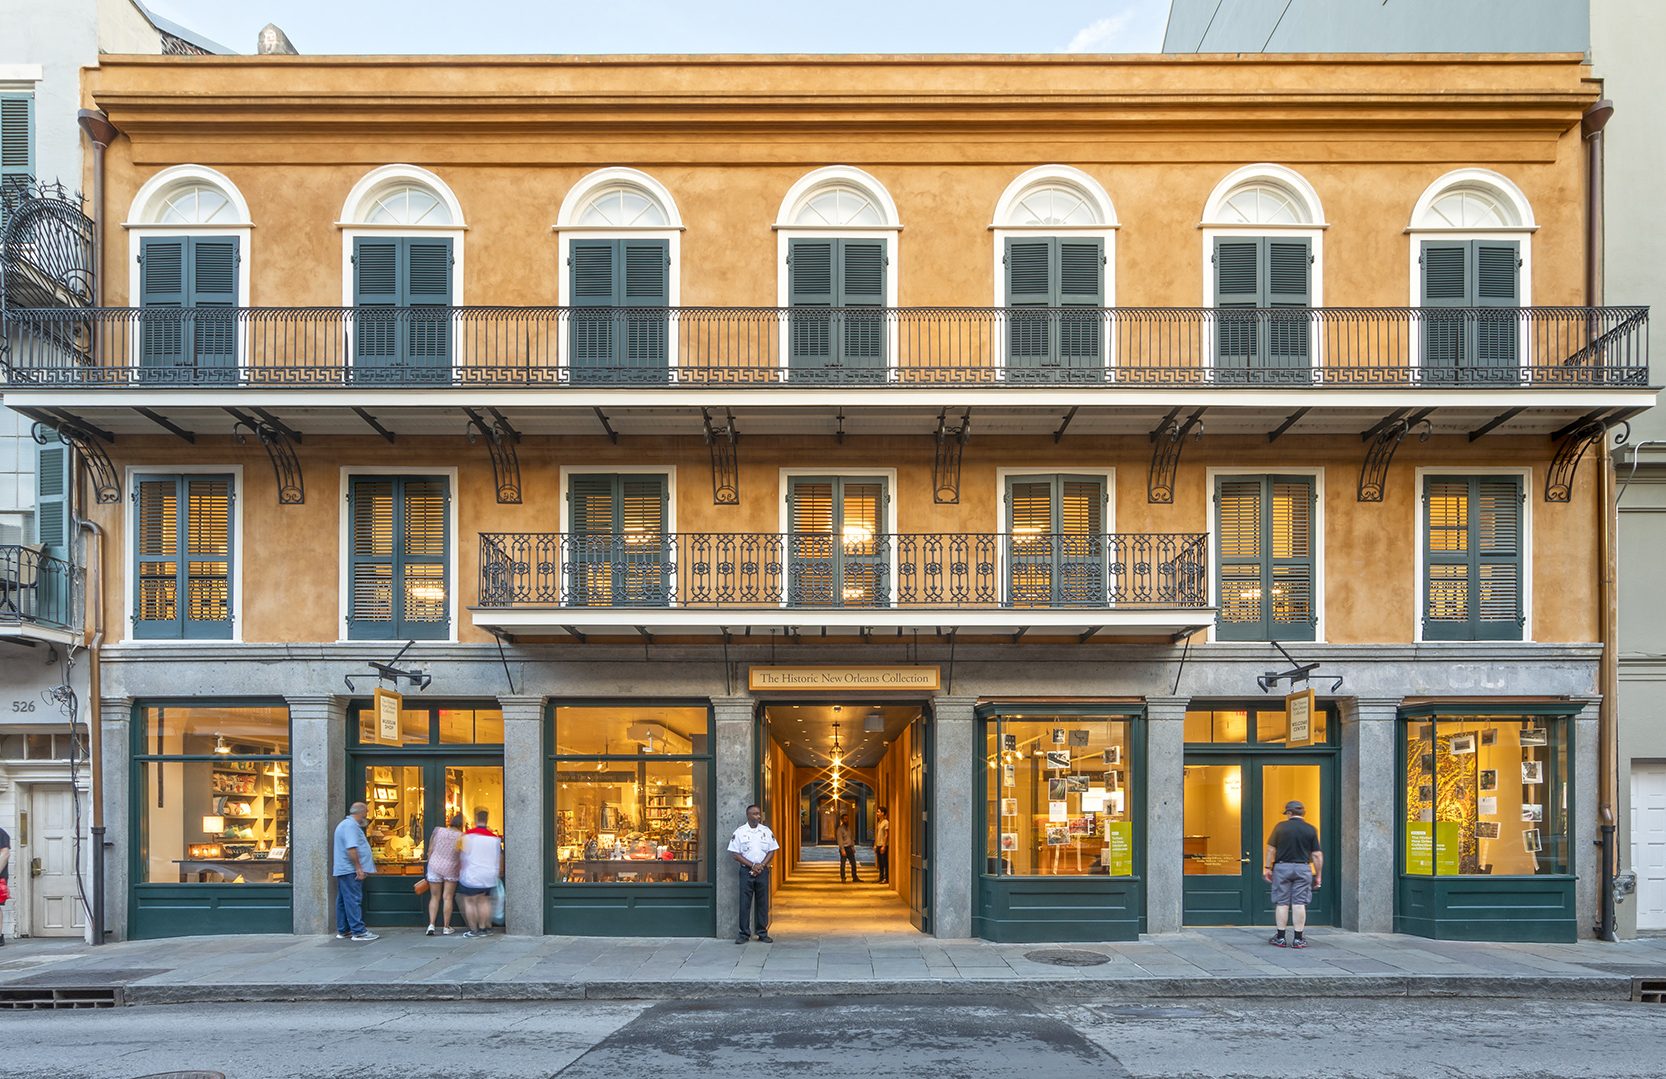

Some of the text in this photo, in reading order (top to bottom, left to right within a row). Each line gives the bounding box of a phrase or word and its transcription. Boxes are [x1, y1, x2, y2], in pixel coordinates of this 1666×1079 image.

[760, 673, 929, 683] The Historic New Orleans Collection
[12, 700, 36, 713] 526
